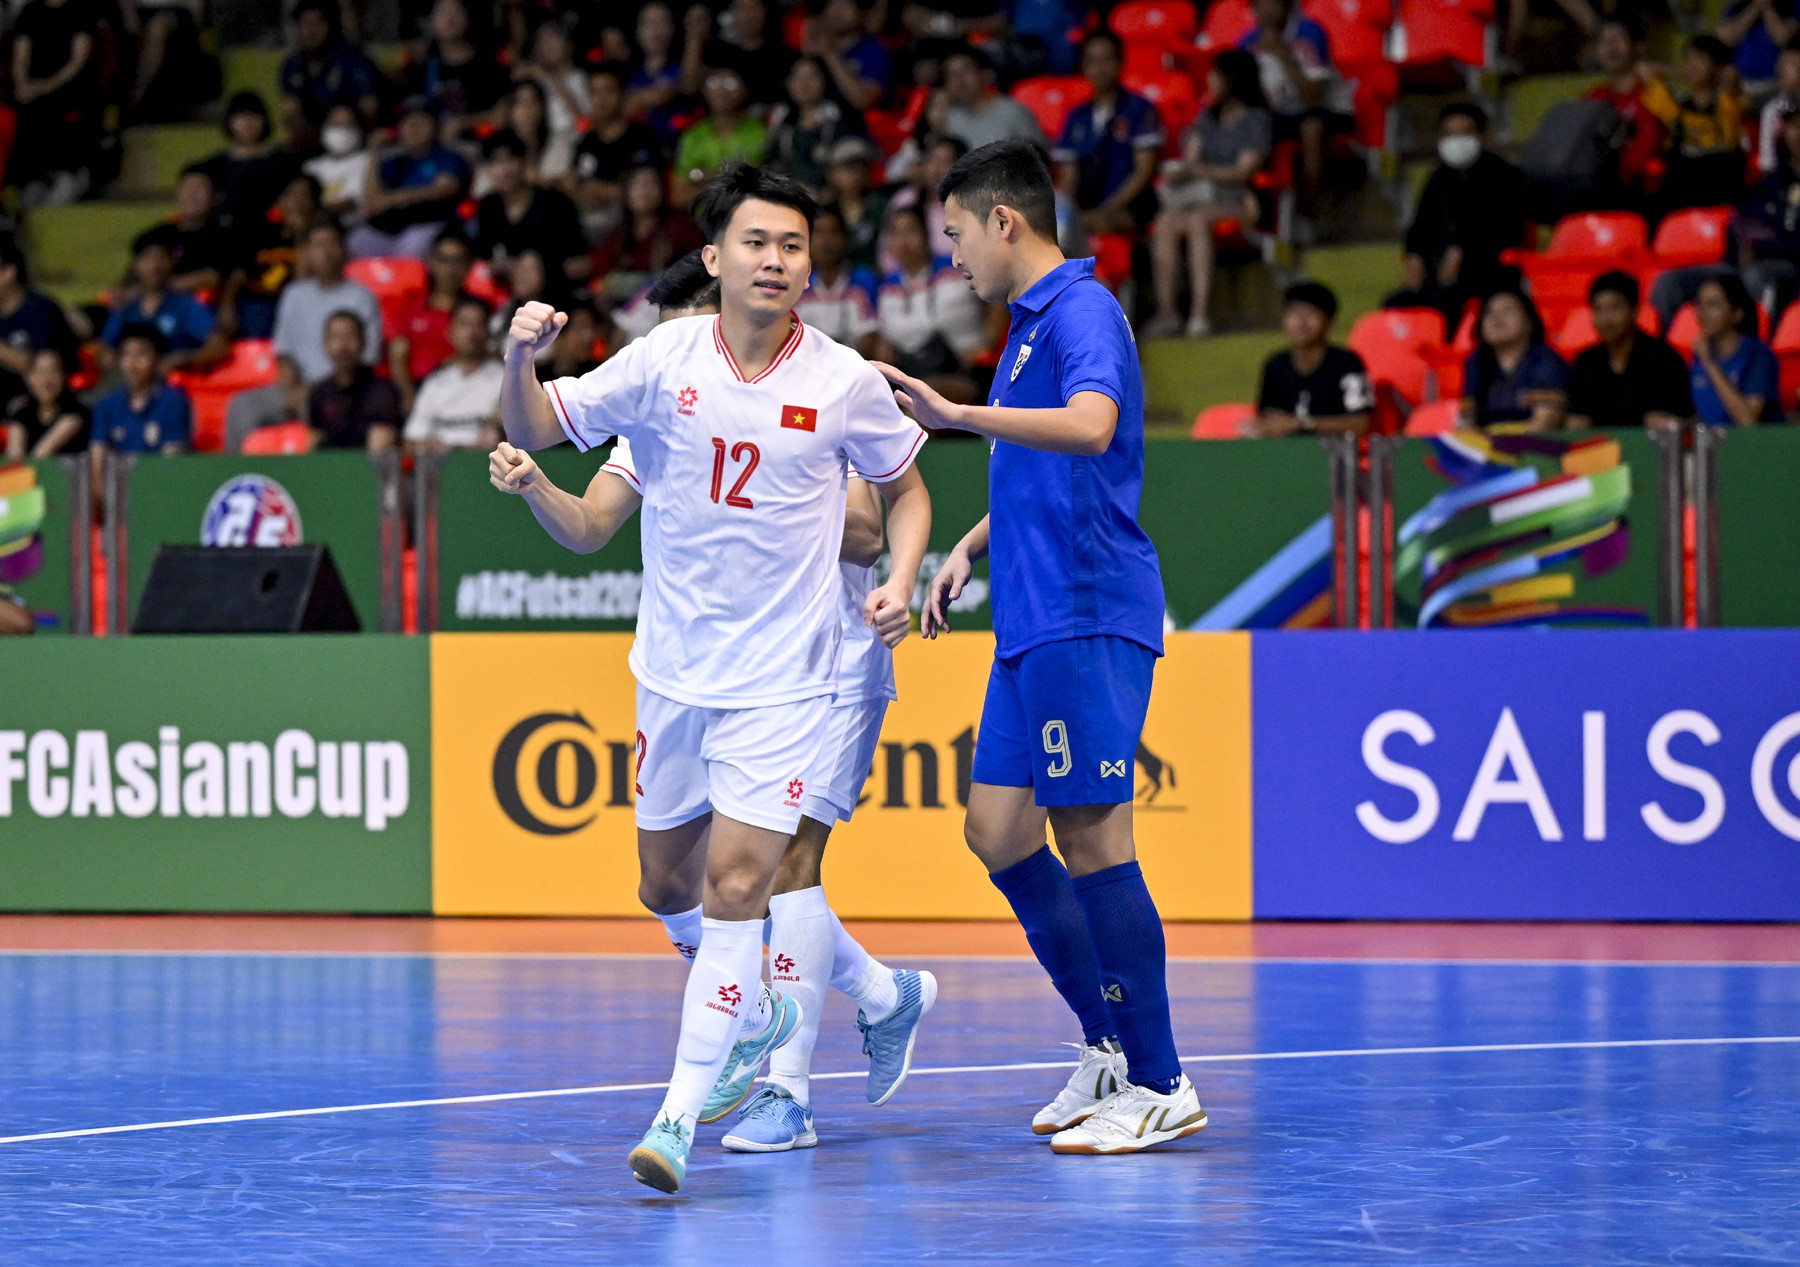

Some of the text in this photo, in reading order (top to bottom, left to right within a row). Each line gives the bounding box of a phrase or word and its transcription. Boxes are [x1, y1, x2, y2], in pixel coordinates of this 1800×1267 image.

[710, 437, 761, 510] 12
[0, 725, 411, 831] FCAsianCup
[1041, 719, 1073, 778] 9
